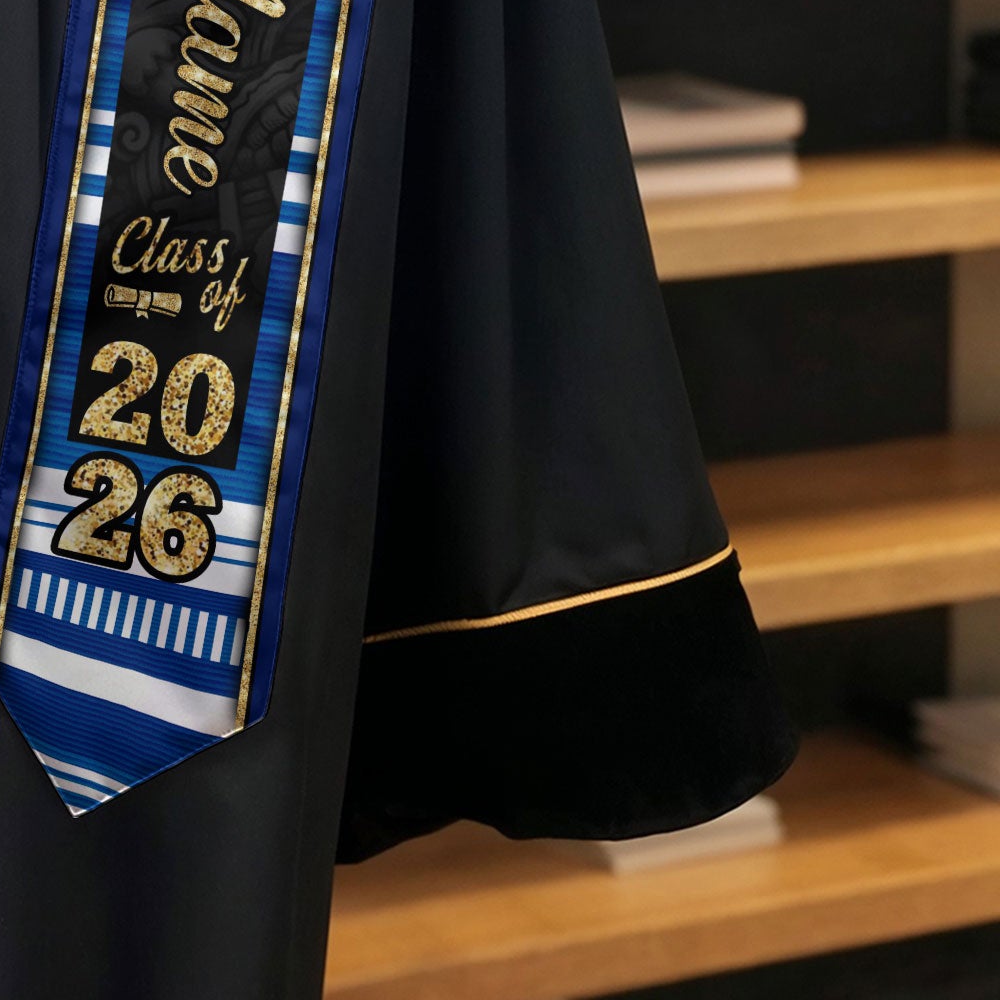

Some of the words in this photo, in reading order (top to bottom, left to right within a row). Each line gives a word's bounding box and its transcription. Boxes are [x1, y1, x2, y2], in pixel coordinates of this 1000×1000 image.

[111, 215, 230, 275] Class
[199, 257, 249, 332] of
[78, 340, 236, 457] 20
[55, 456, 219, 579] 26
